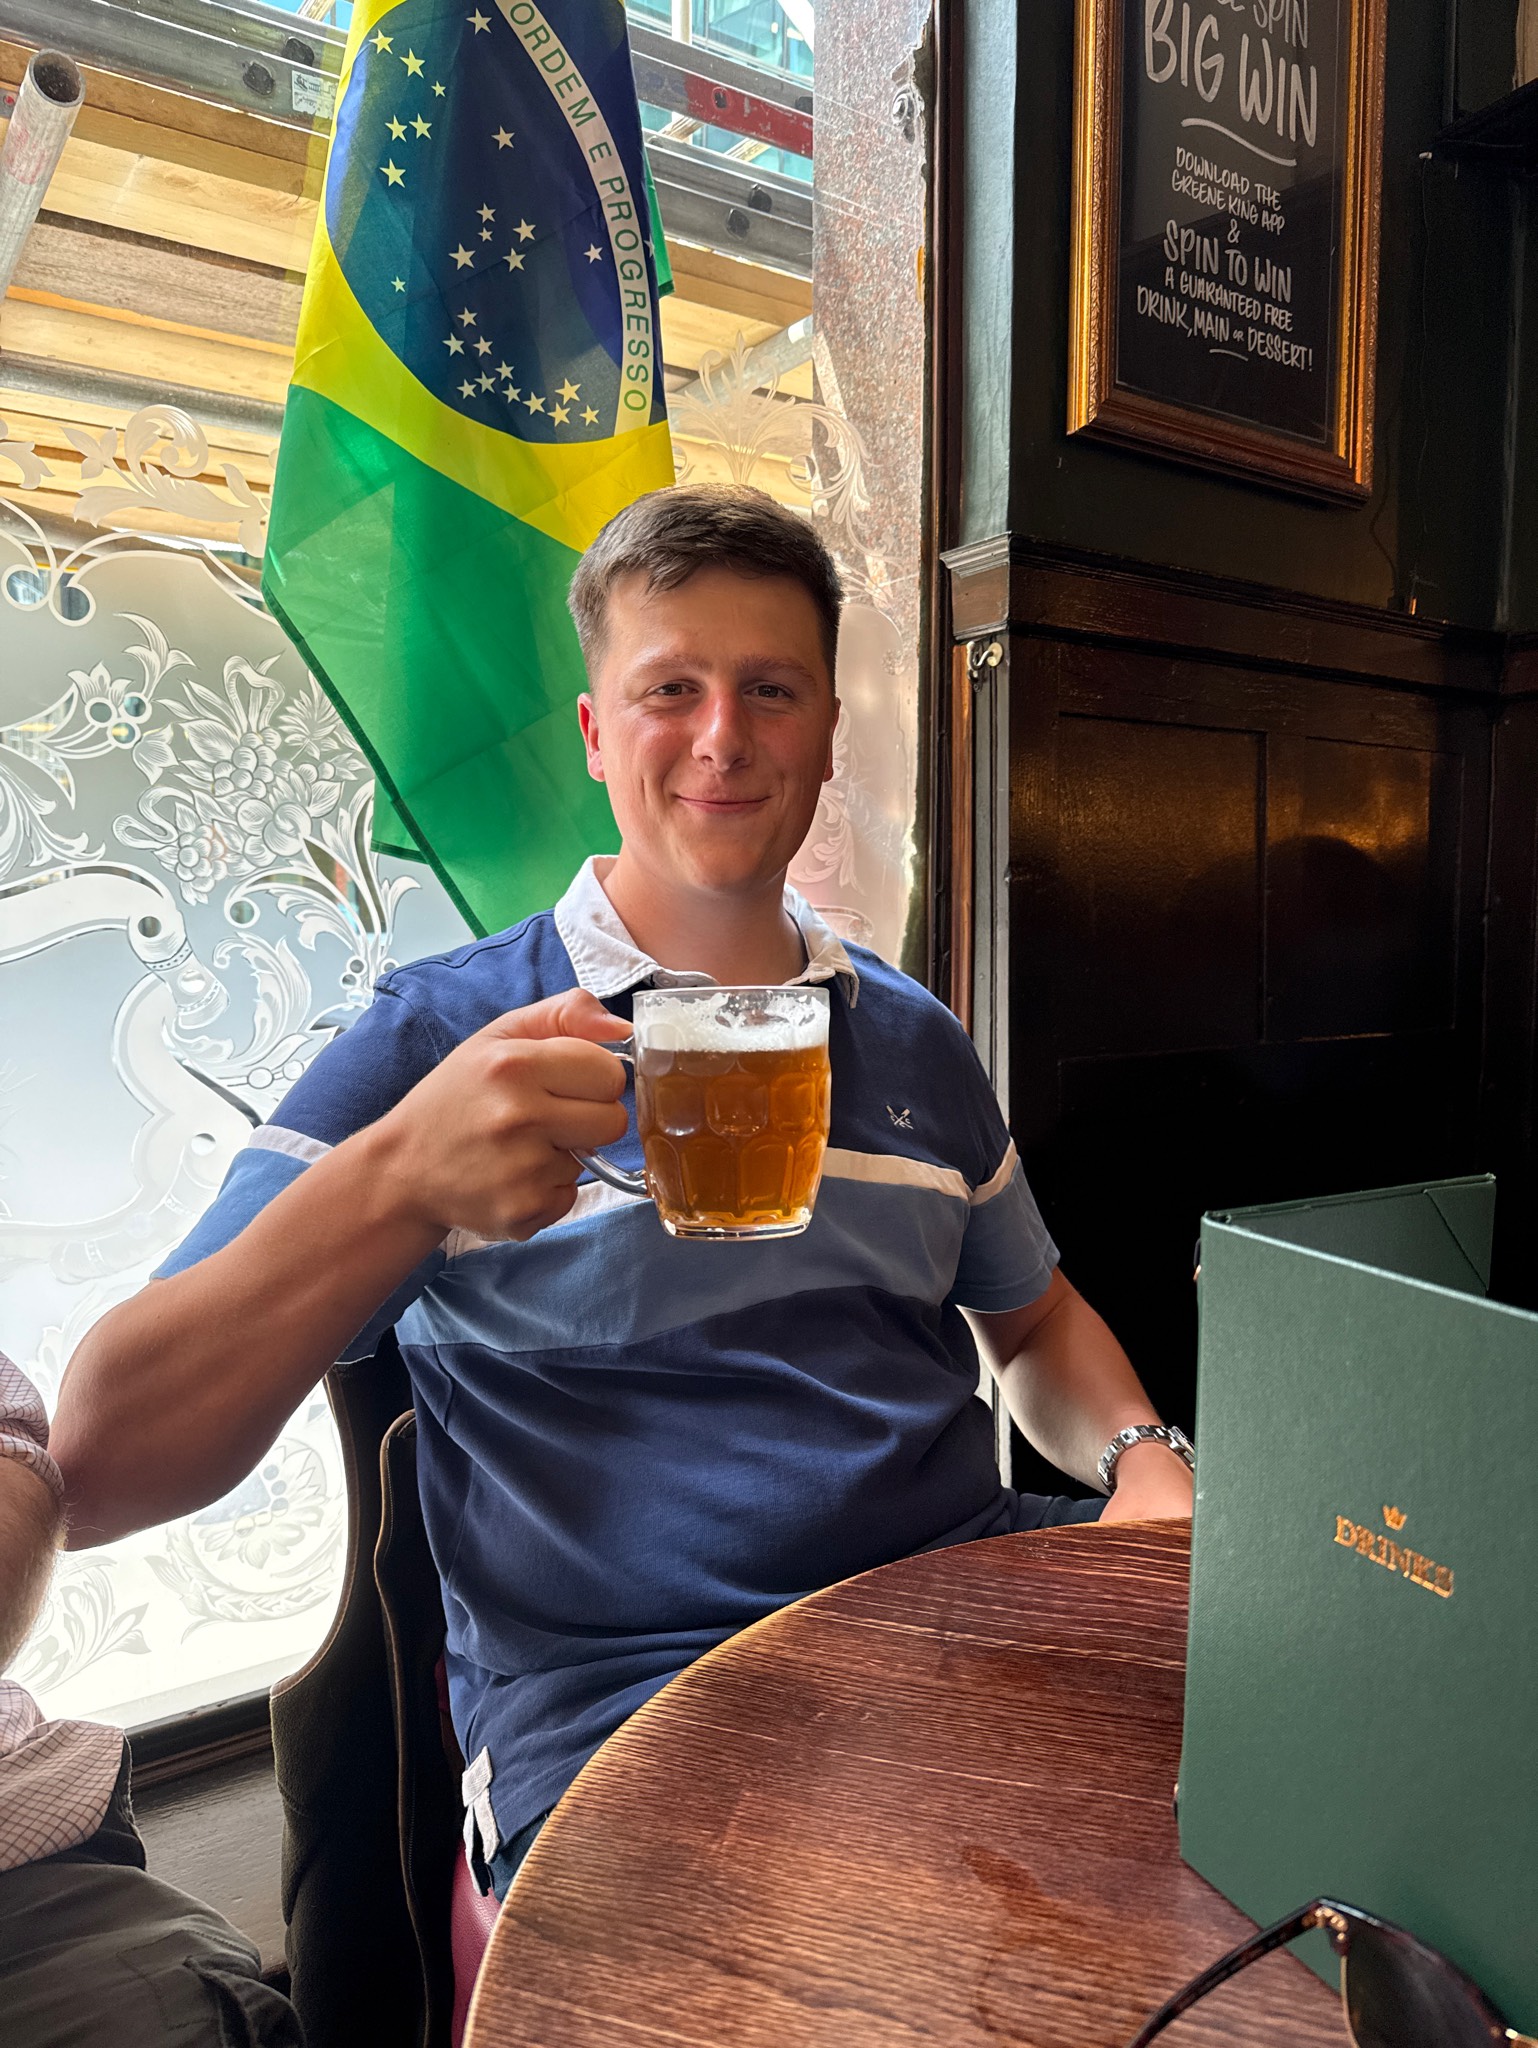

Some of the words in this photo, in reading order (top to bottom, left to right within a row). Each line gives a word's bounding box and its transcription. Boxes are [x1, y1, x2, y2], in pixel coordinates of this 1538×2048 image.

[1145, 0, 1224, 103] BIG
[1239, 34, 1317, 148] WIN
[509, 2, 597, 128] ORDEM
[588, 141, 612, 163] E
[600, 176, 651, 412] PROGRESSO
[1172, 169, 1226, 210] GREENE
[1228, 194, 1258, 225] KING
[1262, 210, 1286, 235] APP
[1176, 146, 1250, 195] DOWNLOAD
[1255, 183, 1282, 211] THE
[1164, 220, 1219, 275] SPIN
[1225, 249, 1248, 286] TO
[1254, 257, 1292, 303] WIN
[1227, 218, 1241, 243] &
[1165, 266, 1174, 289] A
[1180, 271, 1261, 321] GUARANTEED
[1264, 303, 1293, 332] FREE
[1193, 307, 1230, 341] MAIN
[1247, 326, 1313, 372] DESSERT!
[1334, 1515, 1455, 1599] DRINKS
